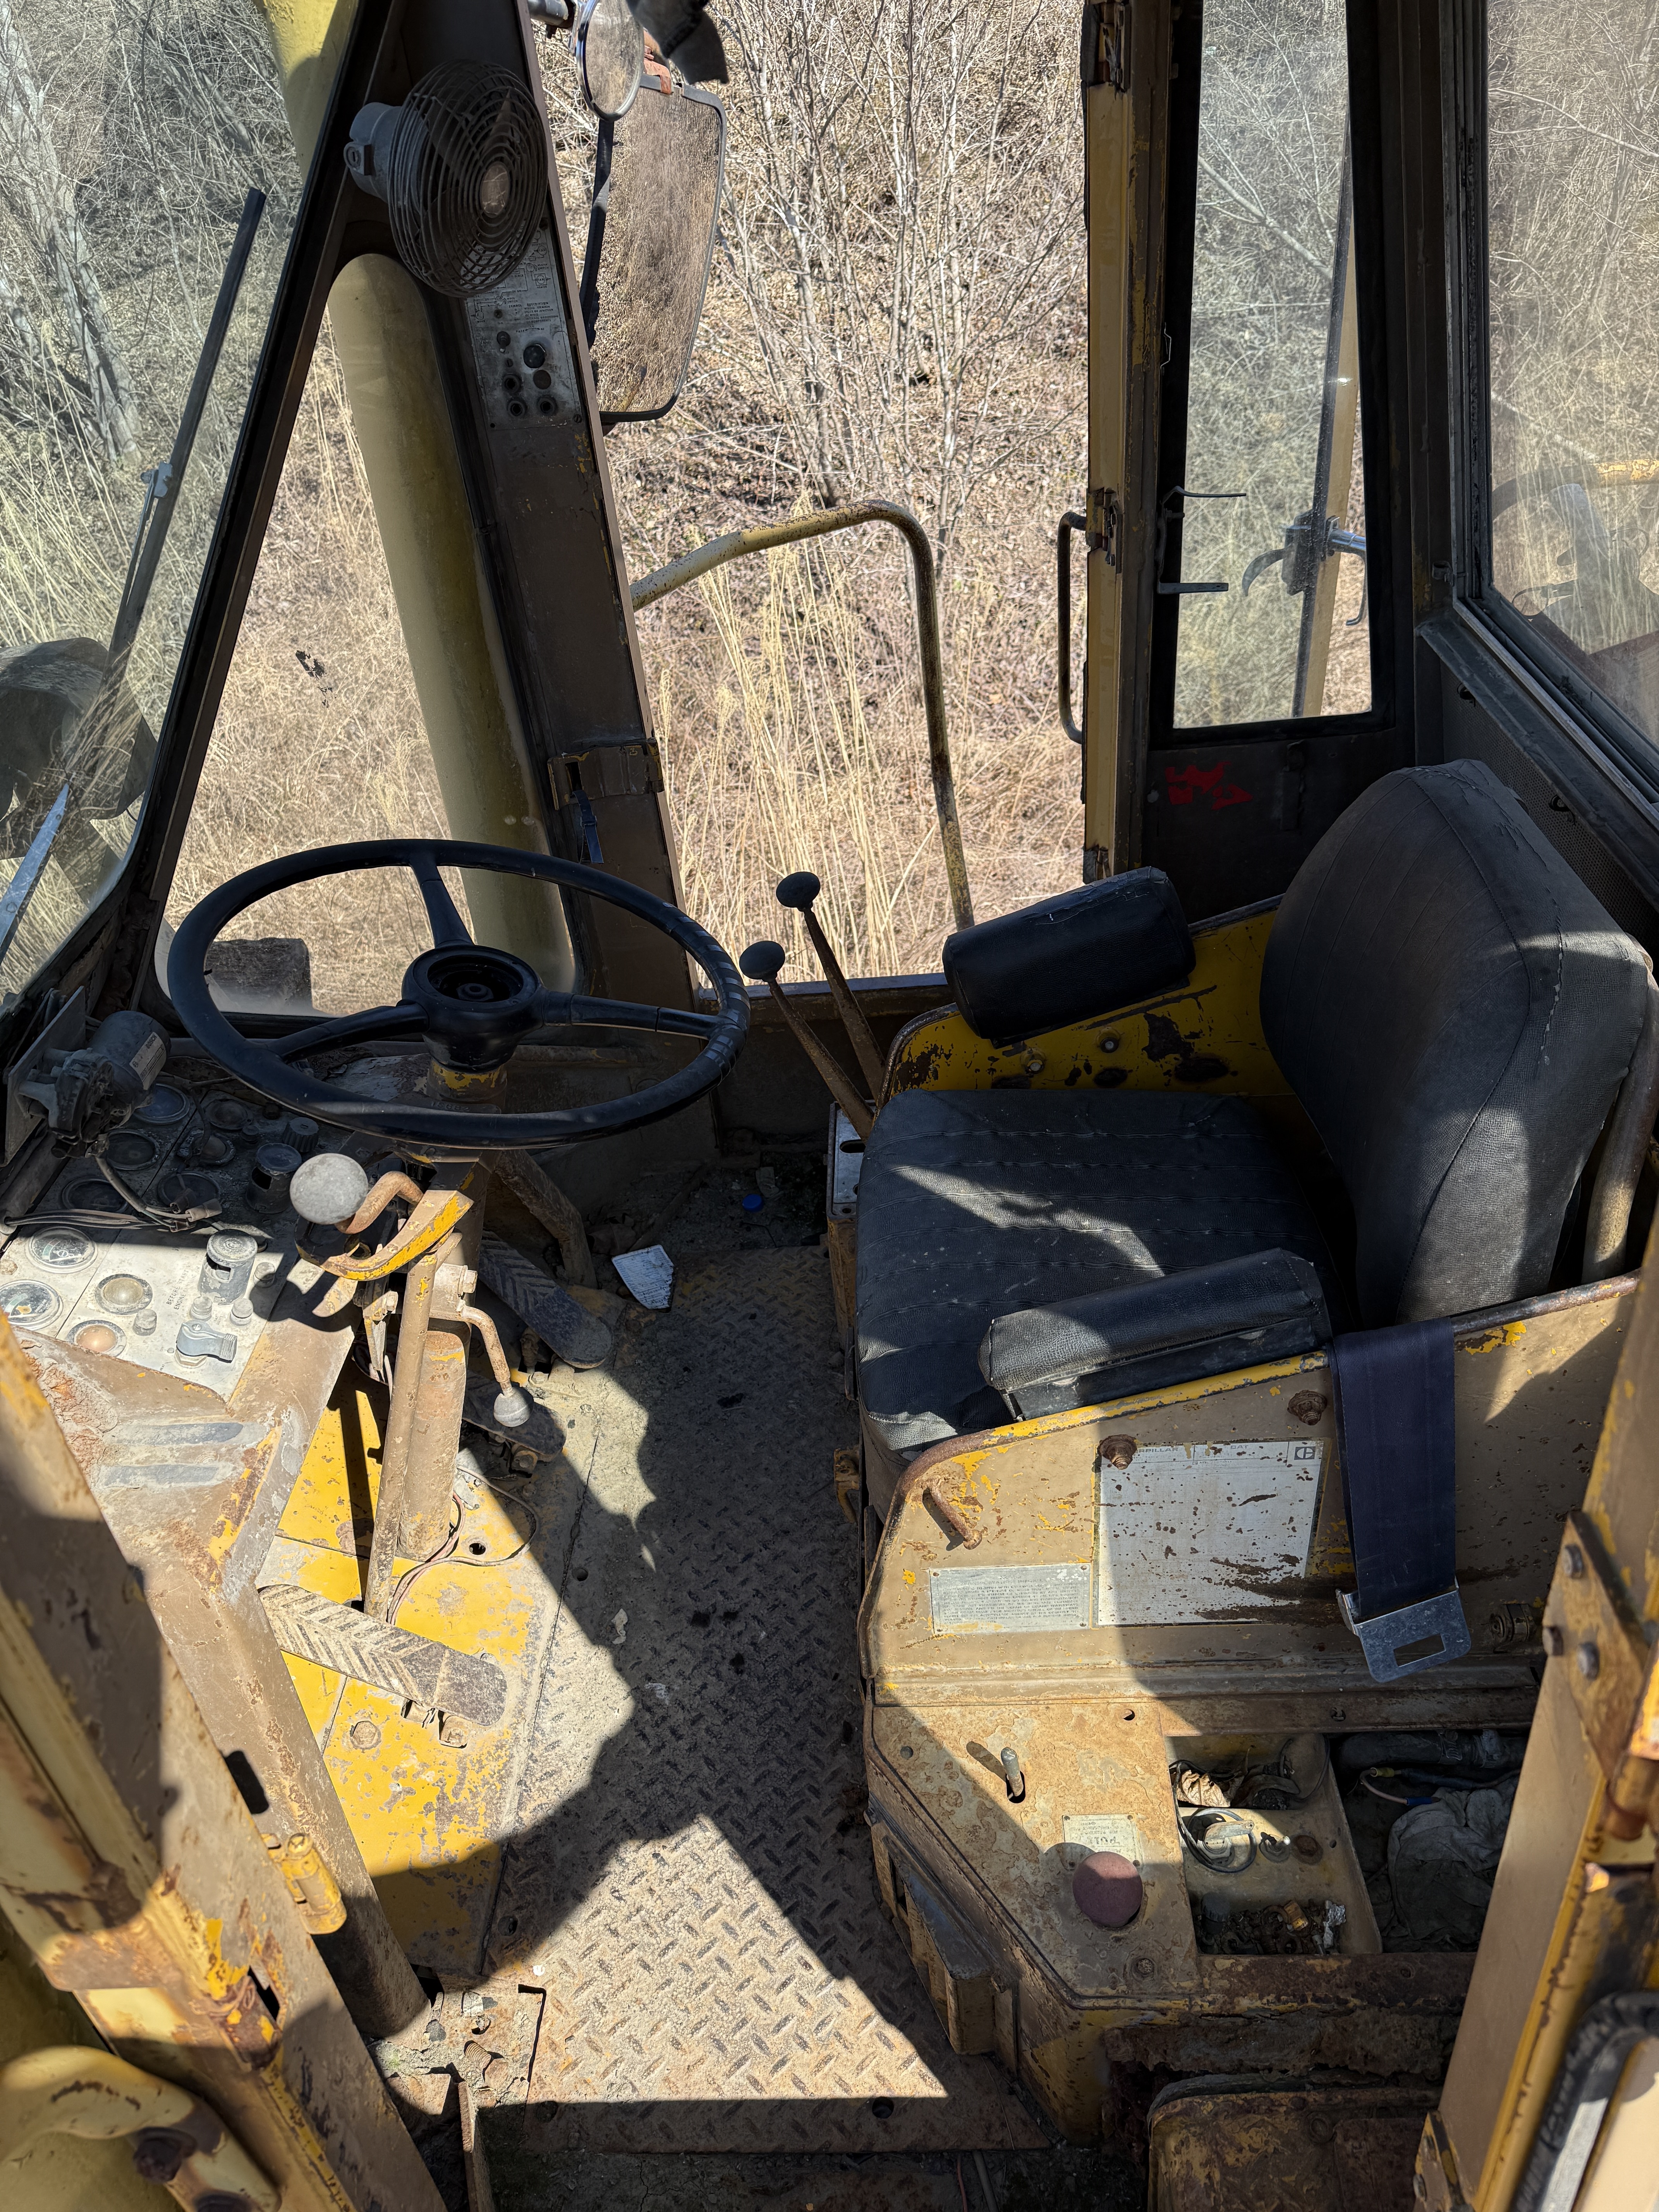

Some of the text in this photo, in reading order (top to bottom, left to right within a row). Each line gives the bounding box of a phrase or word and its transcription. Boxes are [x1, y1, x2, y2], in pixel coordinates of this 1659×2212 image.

[146, 1034, 157, 1049] BOSCH
[166, 1285, 180, 1305] BEFORE
[173, 1293, 186, 1310] ENGINE
